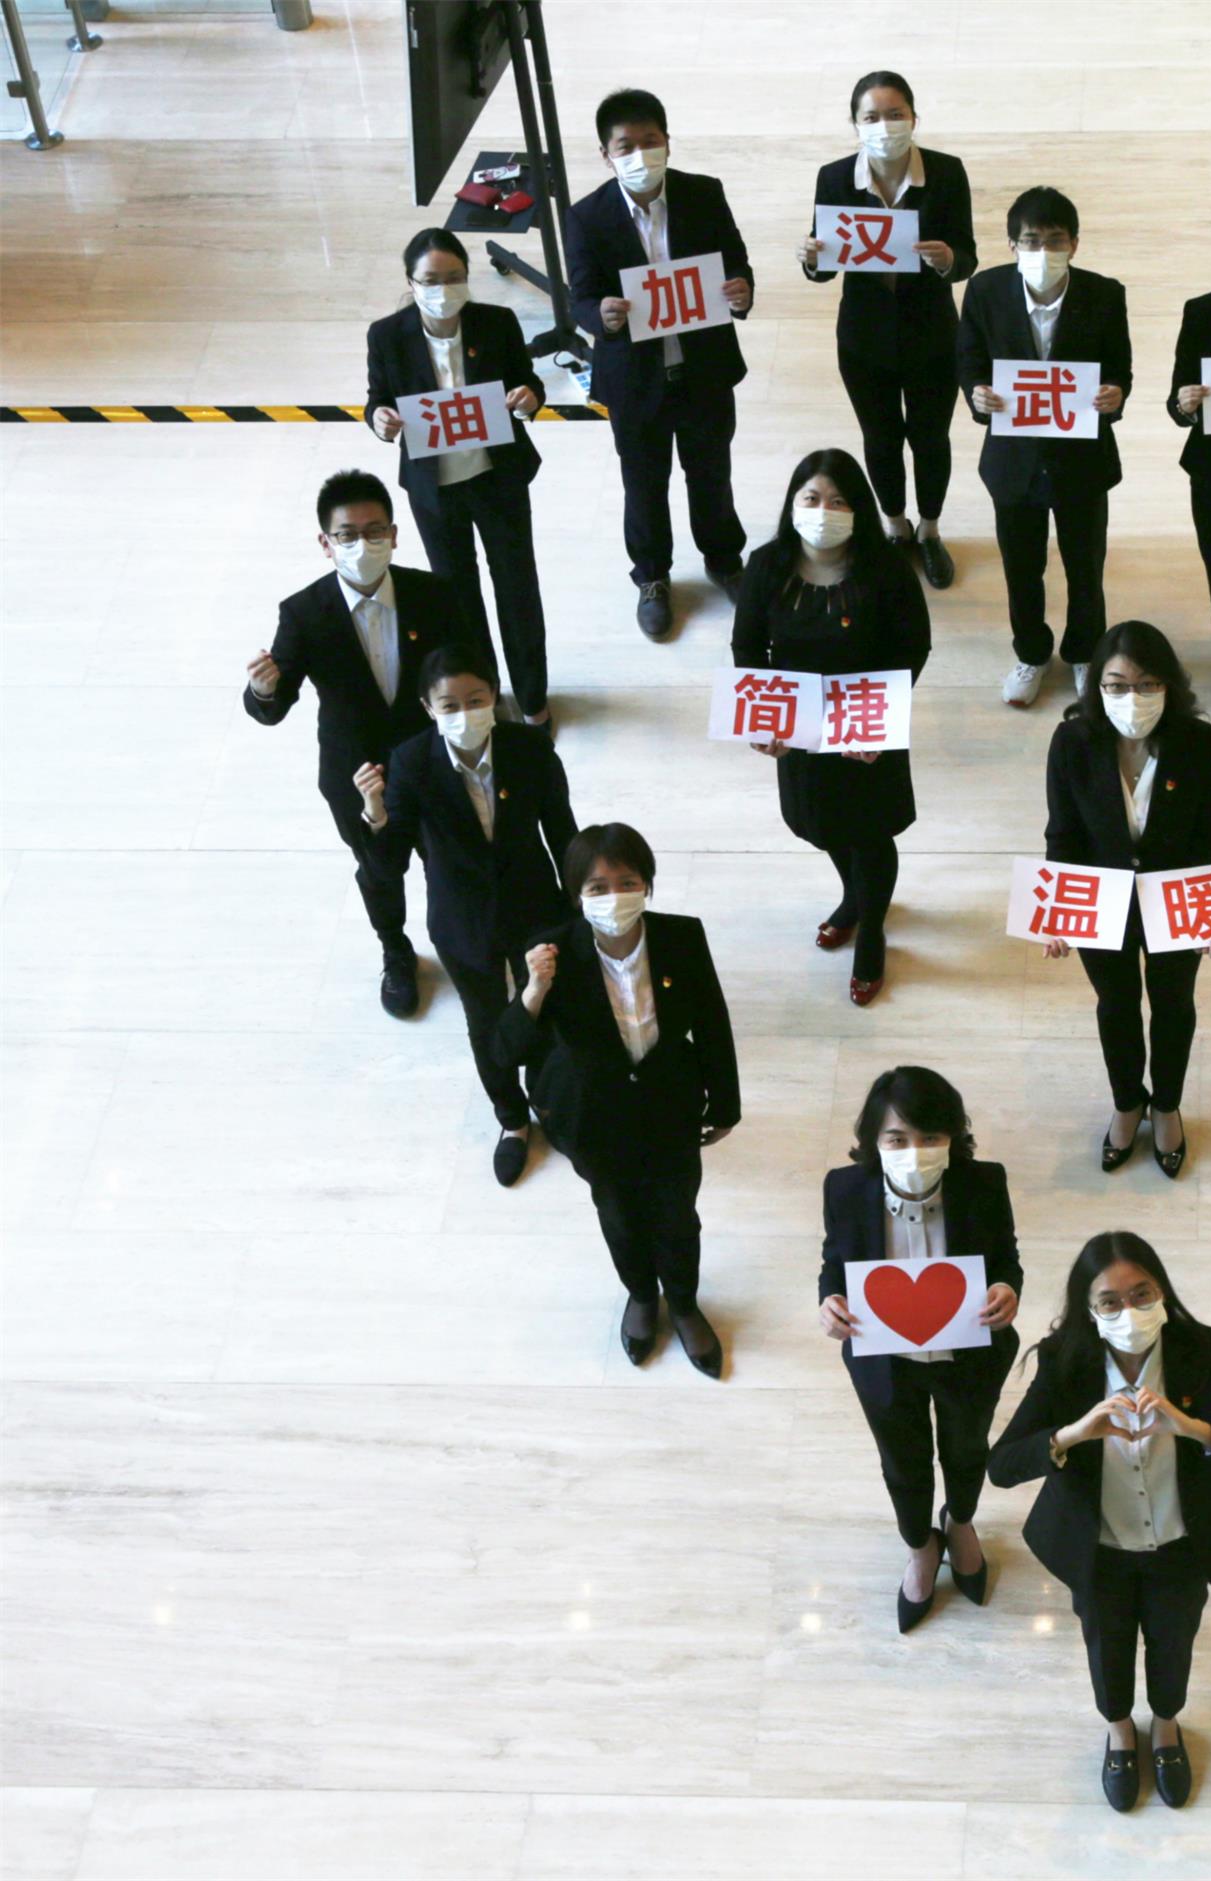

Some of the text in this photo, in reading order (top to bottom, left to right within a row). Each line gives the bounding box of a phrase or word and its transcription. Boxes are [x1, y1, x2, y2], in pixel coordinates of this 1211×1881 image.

[836, 213, 895, 264] 汉
[642, 267, 706, 330] 加
[421, 393, 488, 449] 油
[1012, 366, 1077, 432] 武
[733, 674, 798, 741] 简
[826, 678, 888, 746] 捷
[1028, 867, 1101, 940] 温
